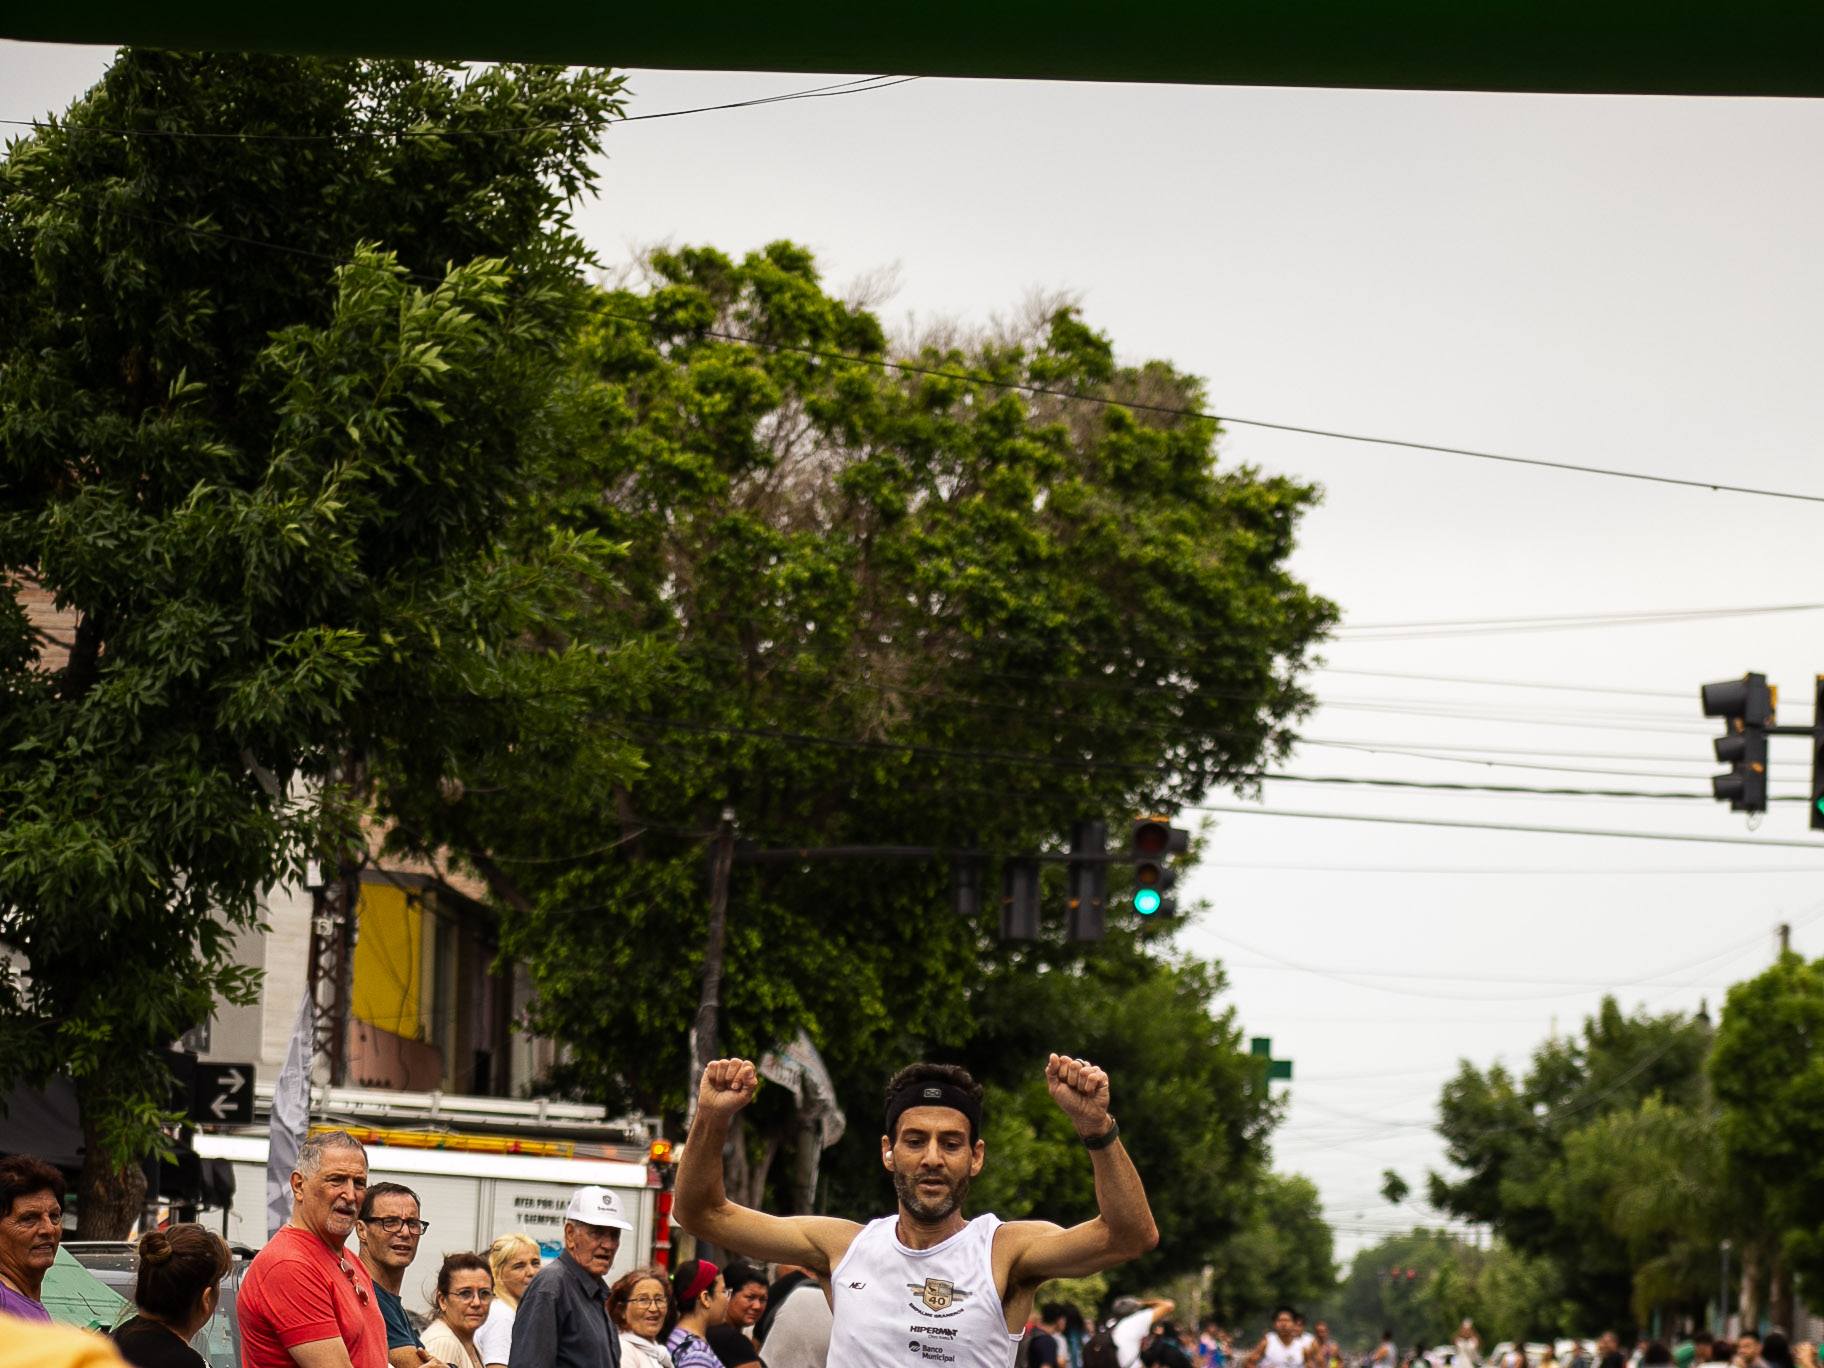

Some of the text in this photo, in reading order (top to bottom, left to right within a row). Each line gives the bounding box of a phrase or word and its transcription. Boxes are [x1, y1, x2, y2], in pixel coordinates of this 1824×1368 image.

[929, 1296, 946, 1306] 40
[908, 1302, 964, 1318] EMPALME GRANEROS
[922, 1345, 943, 1354] Banco
[922, 1353, 955, 1363] Municipal
